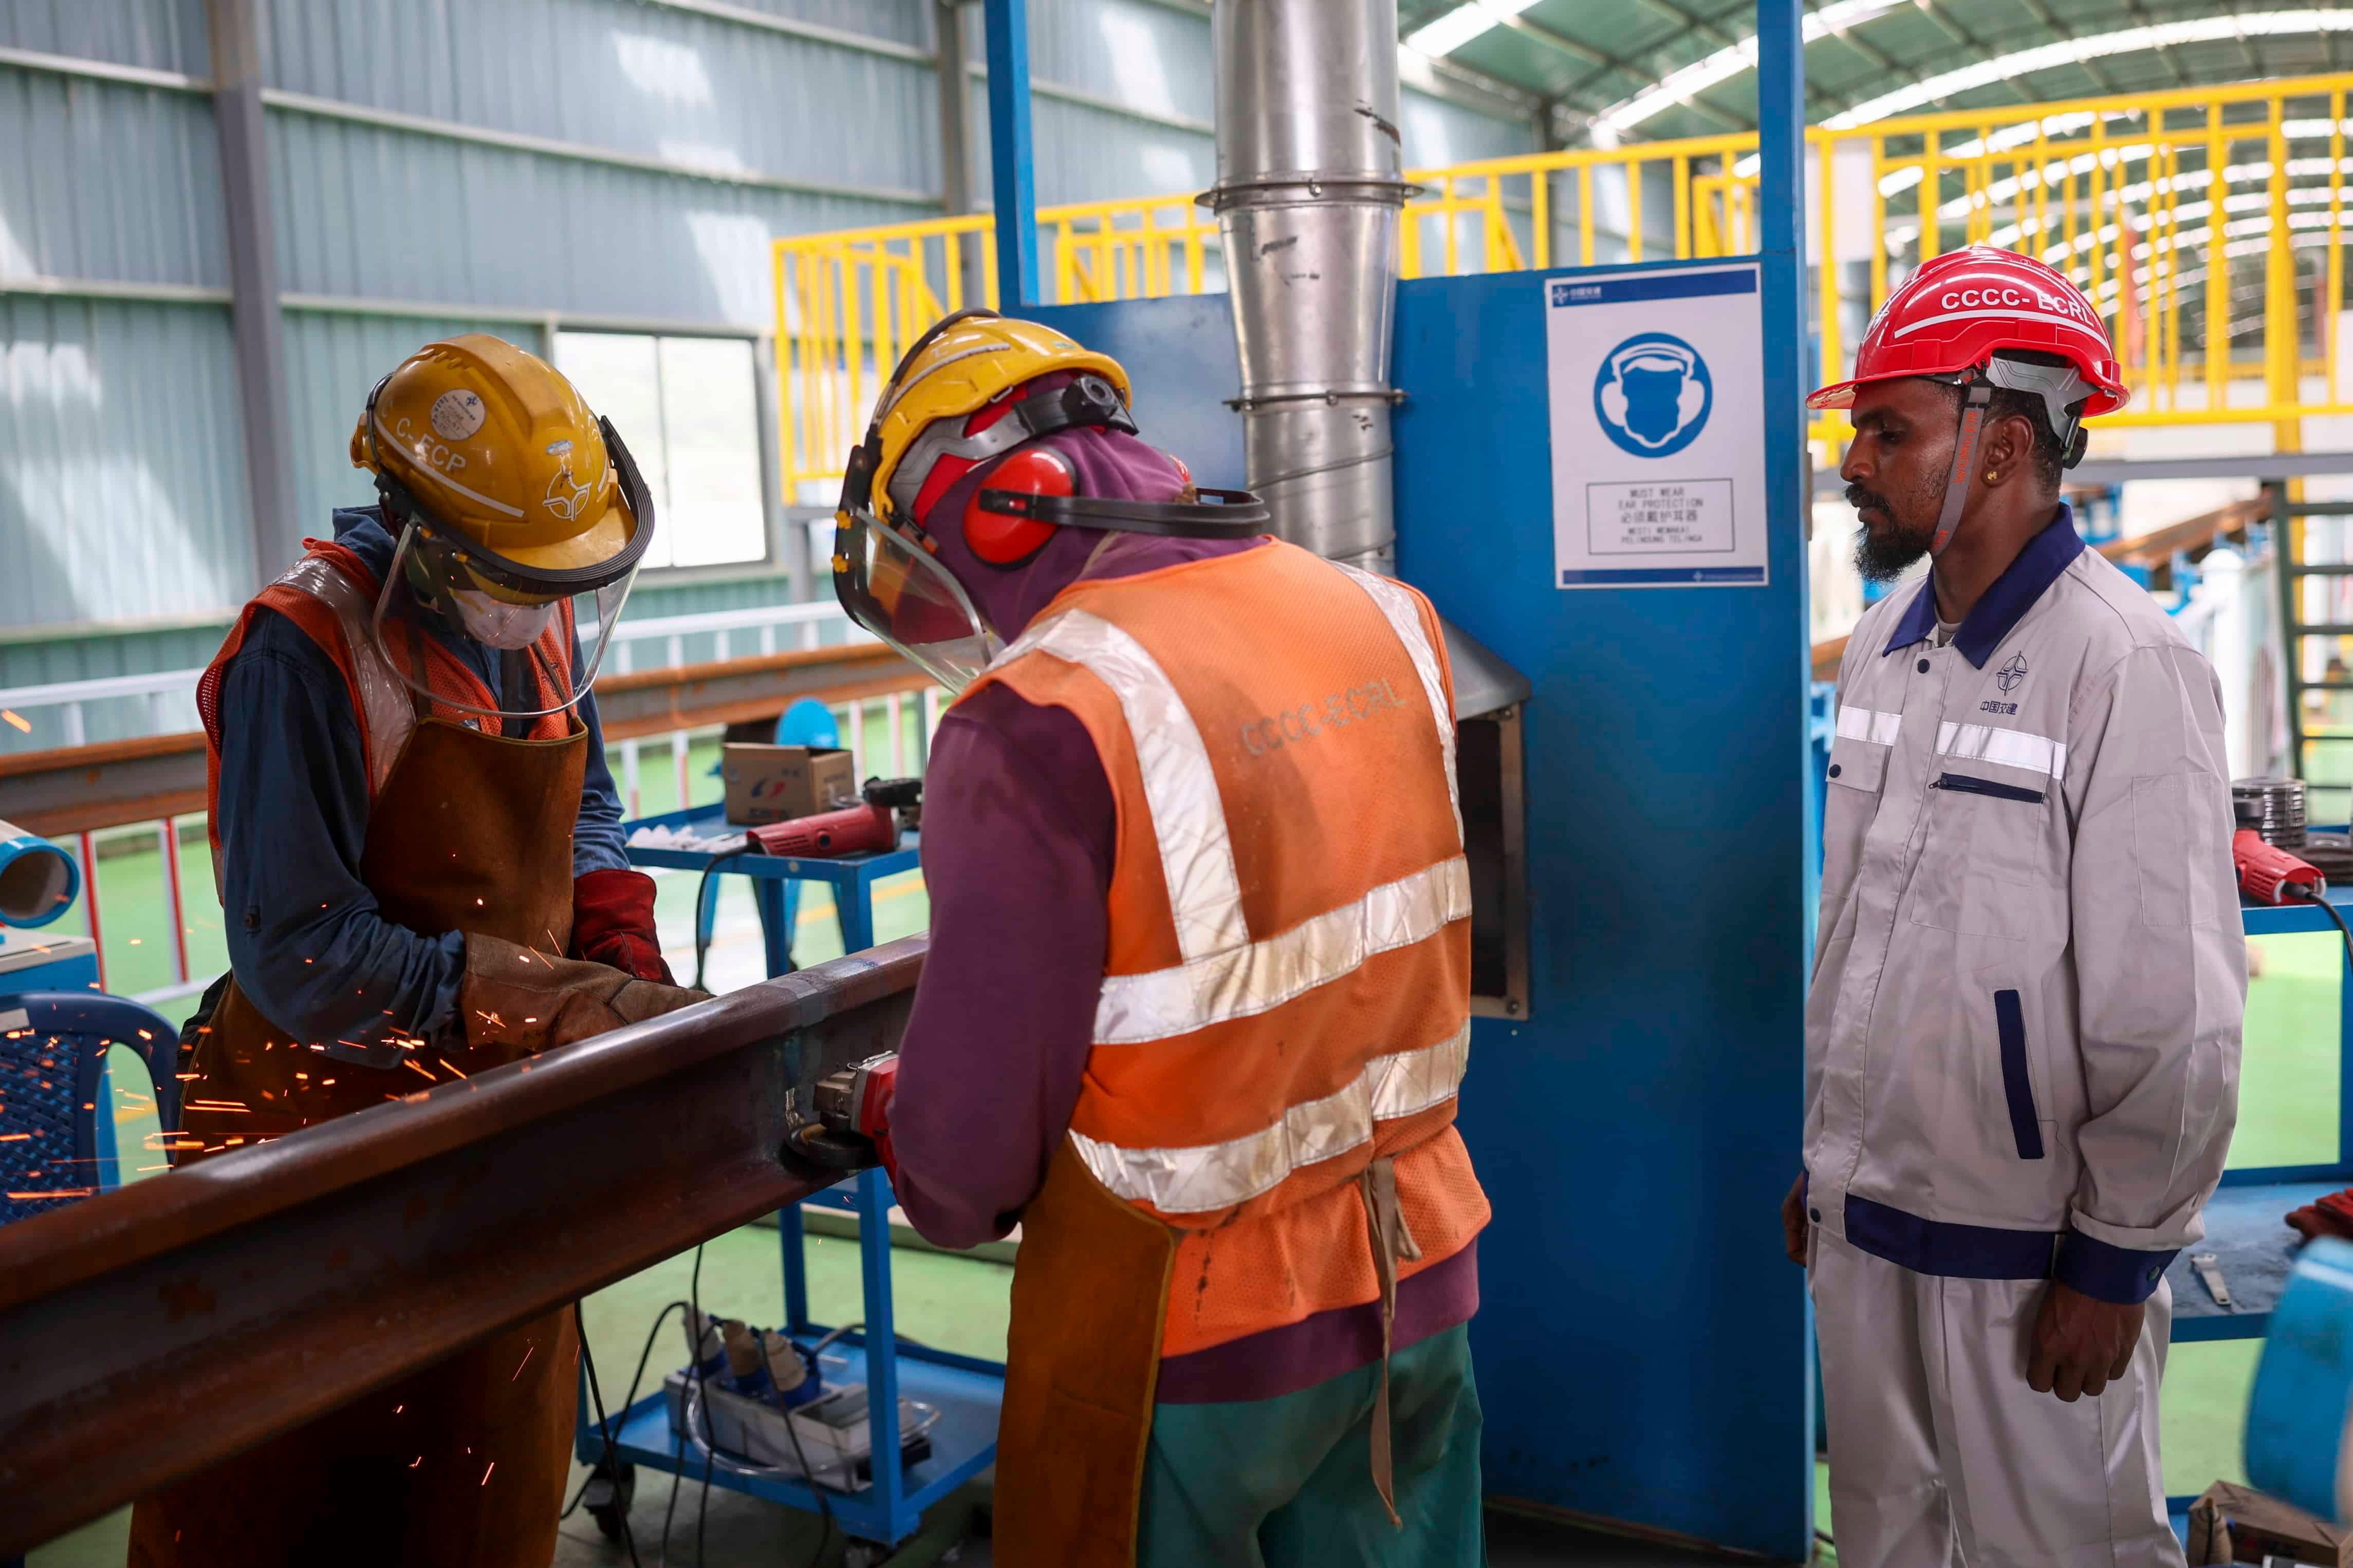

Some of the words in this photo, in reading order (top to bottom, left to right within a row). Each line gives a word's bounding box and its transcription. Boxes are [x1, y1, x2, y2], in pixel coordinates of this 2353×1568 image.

[1241, 677, 1407, 757] CCCC-ECRL
[1980, 700, 2018, 715] 中国交建
